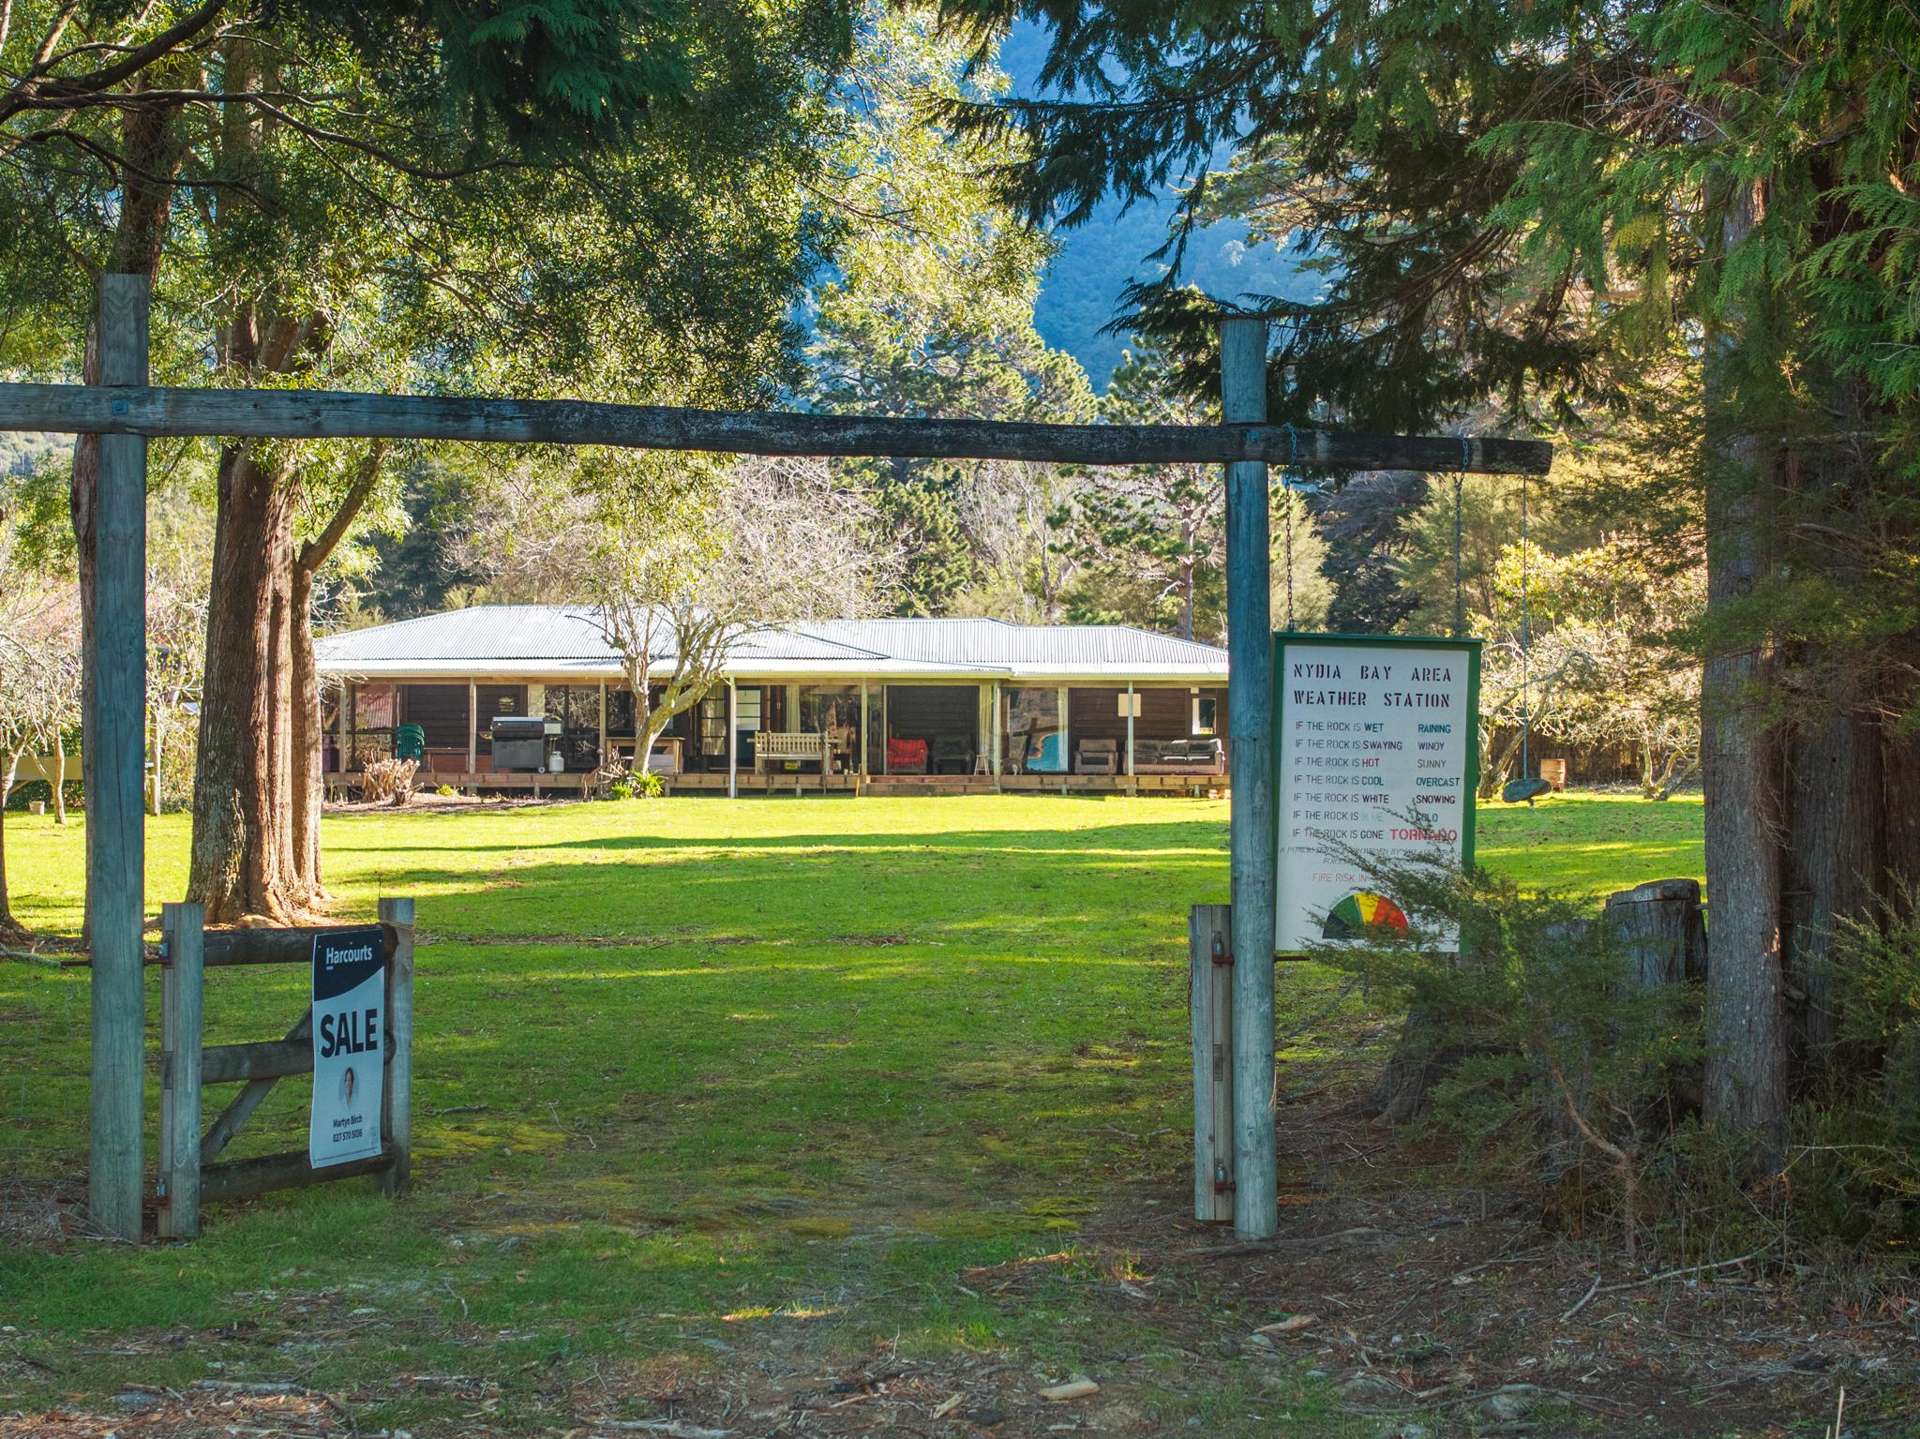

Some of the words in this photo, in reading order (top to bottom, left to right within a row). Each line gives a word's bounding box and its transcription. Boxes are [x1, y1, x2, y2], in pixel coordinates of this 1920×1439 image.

[1293, 663, 1342, 680] NYDIA
[1360, 665, 1392, 680] BAY
[1411, 667, 1452, 682] AREA
[1293, 690, 1367, 706] WEATHER
[1384, 692, 1450, 708] STATION
[1295, 721, 1304, 731] IF
[1307, 721, 1324, 731] THE
[1327, 722, 1351, 732] ROCK
[1353, 722, 1361, 732] IS
[1364, 722, 1384, 733] WET
[1418, 724, 1452, 734] RAINING
[1295, 739, 1304, 748] IF
[1307, 739, 1324, 749] THE
[1327, 739, 1350, 750] ROCK
[1352, 740, 1360, 749] IS
[1362, 741, 1403, 751] SWAYING
[1418, 742, 1445, 752] WINDY
[1294, 757, 1303, 766] IF
[1306, 757, 1323, 767] THE
[1326, 757, 1350, 767] ROCK
[1352, 758, 1360, 767] IS
[1362, 758, 1380, 768] HOT
[1417, 759, 1446, 769] SUNNY
[1294, 774, 1302, 784] IF
[1306, 775, 1323, 785] THE
[1326, 775, 1349, 785] ROCK
[1351, 776, 1360, 785] IS
[1361, 776, 1384, 786] COOL
[1416, 777, 1460, 787] OVERCAST
[1293, 792, 1302, 802] IF
[1305, 793, 1322, 802] THE
[1325, 793, 1349, 803] ROCK
[1351, 793, 1360, 803] IS
[1362, 793, 1389, 804] WHITE
[1416, 795, 1456, 805] SNOWING
[1293, 810, 1301, 820] IF
[1305, 810, 1321, 820] THE
[1324, 811, 1348, 821] ROCK
[1350, 811, 1359, 820] IS
[1292, 828, 1301, 838] IF
[1350, 829, 1358, 839] IS
[1360, 830, 1383, 840] GONE
[1312, 873, 1332, 882] FIRE
[1335, 873, 1356, 882] RISK
[325, 944, 372, 966] Harcourts
[320, 1008, 378, 1058] SALE
